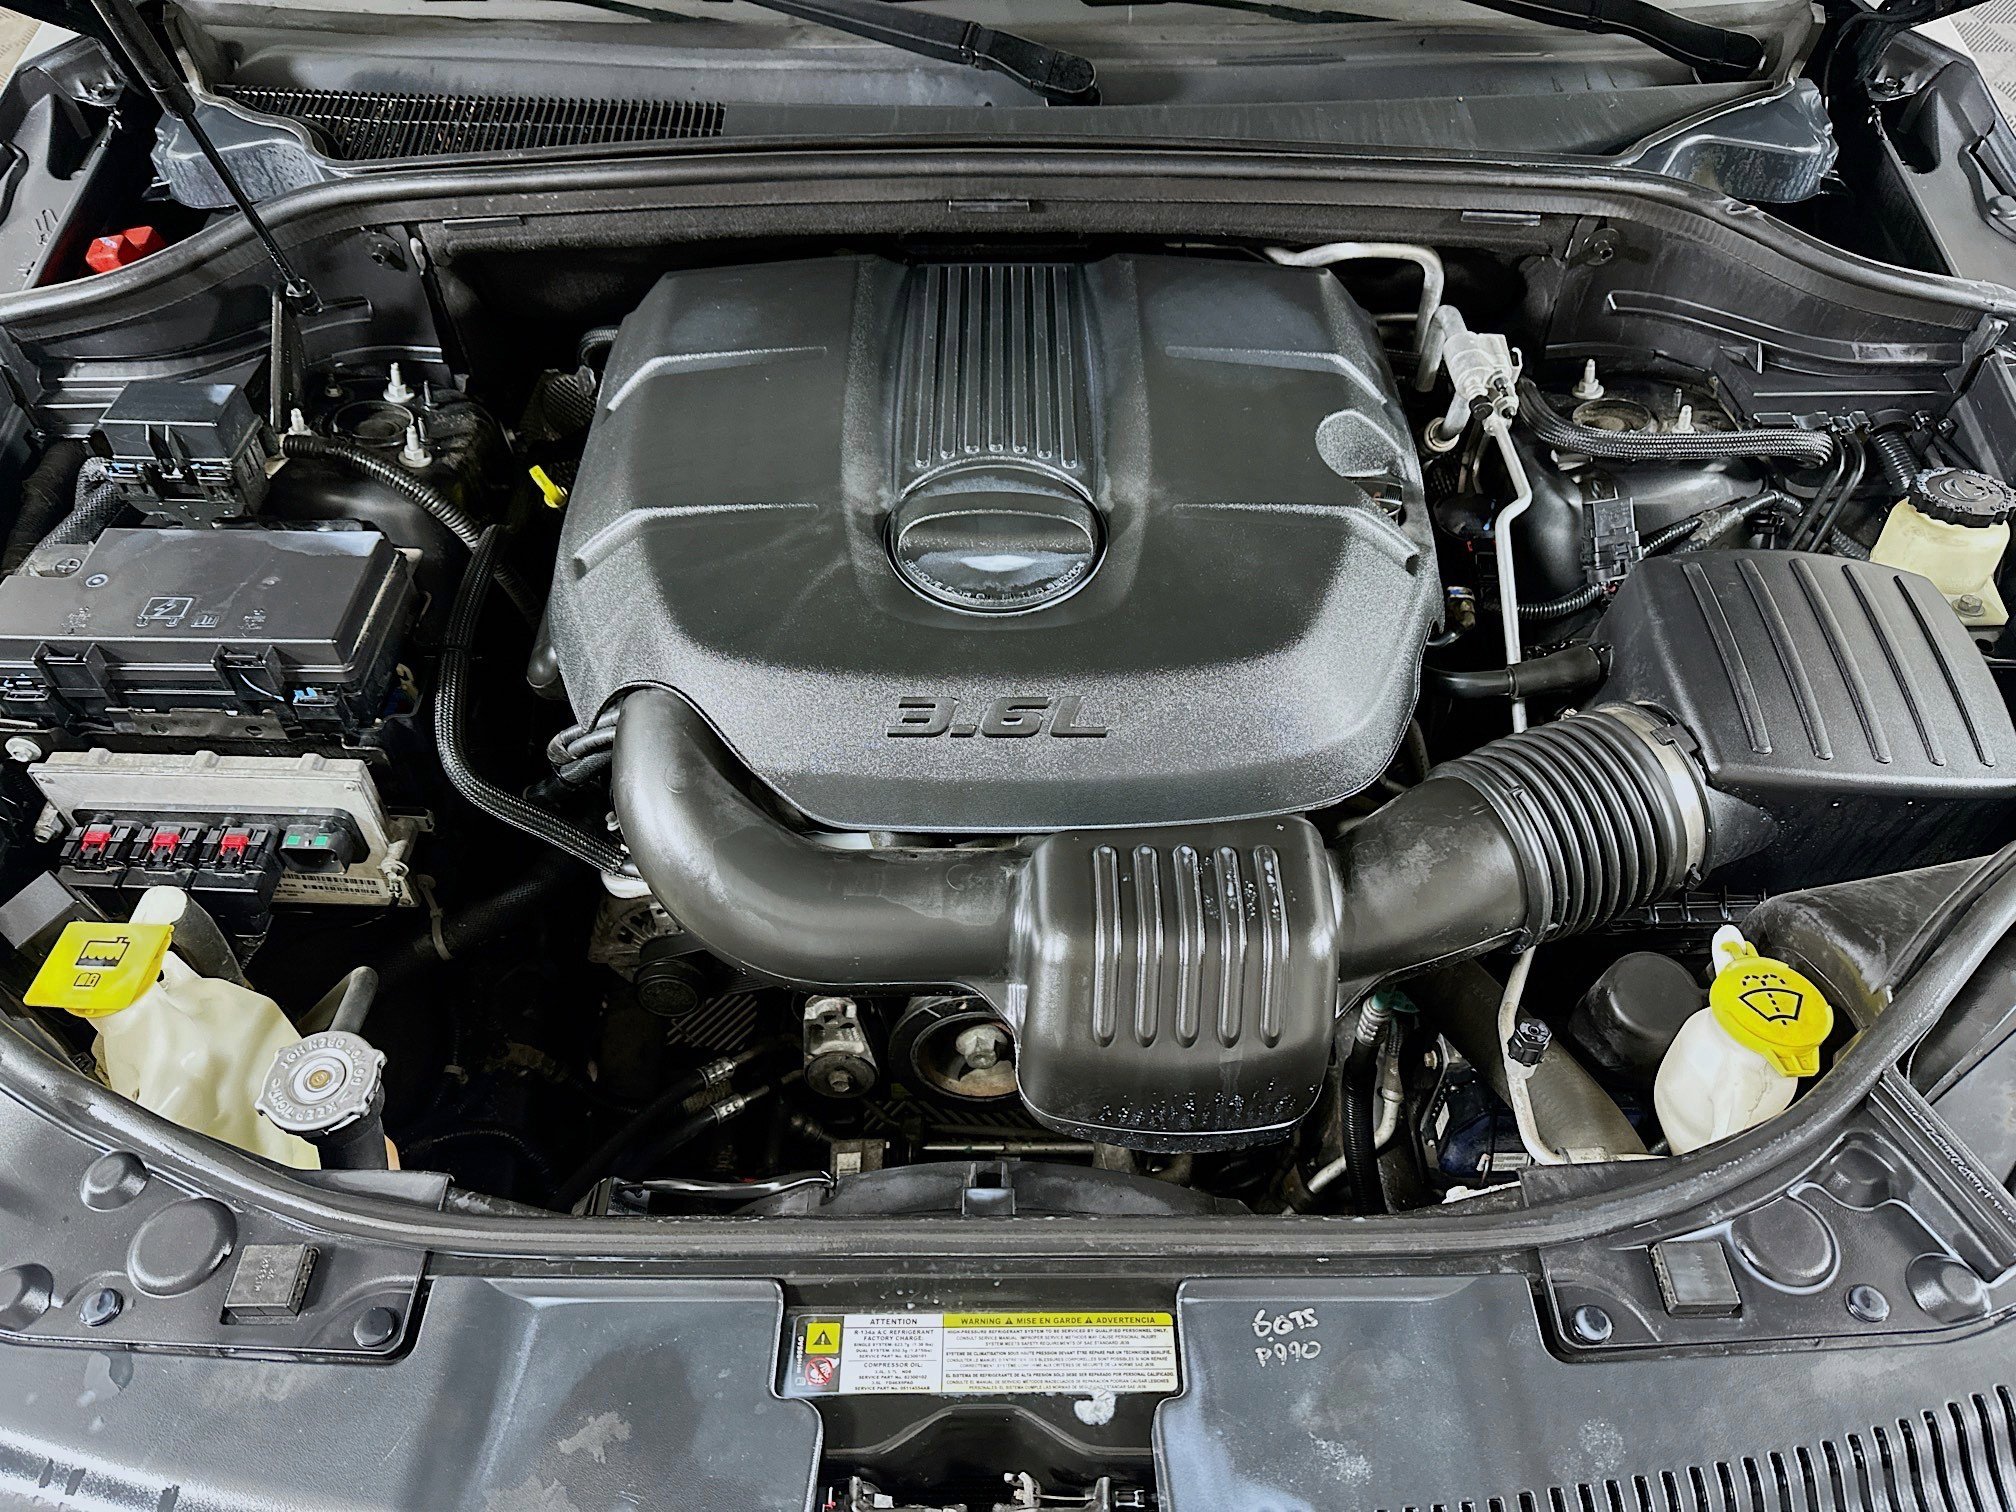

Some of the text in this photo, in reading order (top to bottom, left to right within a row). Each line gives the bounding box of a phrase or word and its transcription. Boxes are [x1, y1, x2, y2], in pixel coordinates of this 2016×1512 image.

[904, 559, 943, 590] REMOVE
[1046, 561, 1086, 592] SERVICE
[887, 696, 1109, 738] 3.6L
[268, 1090, 338, 1120] KEEP TIGHT
